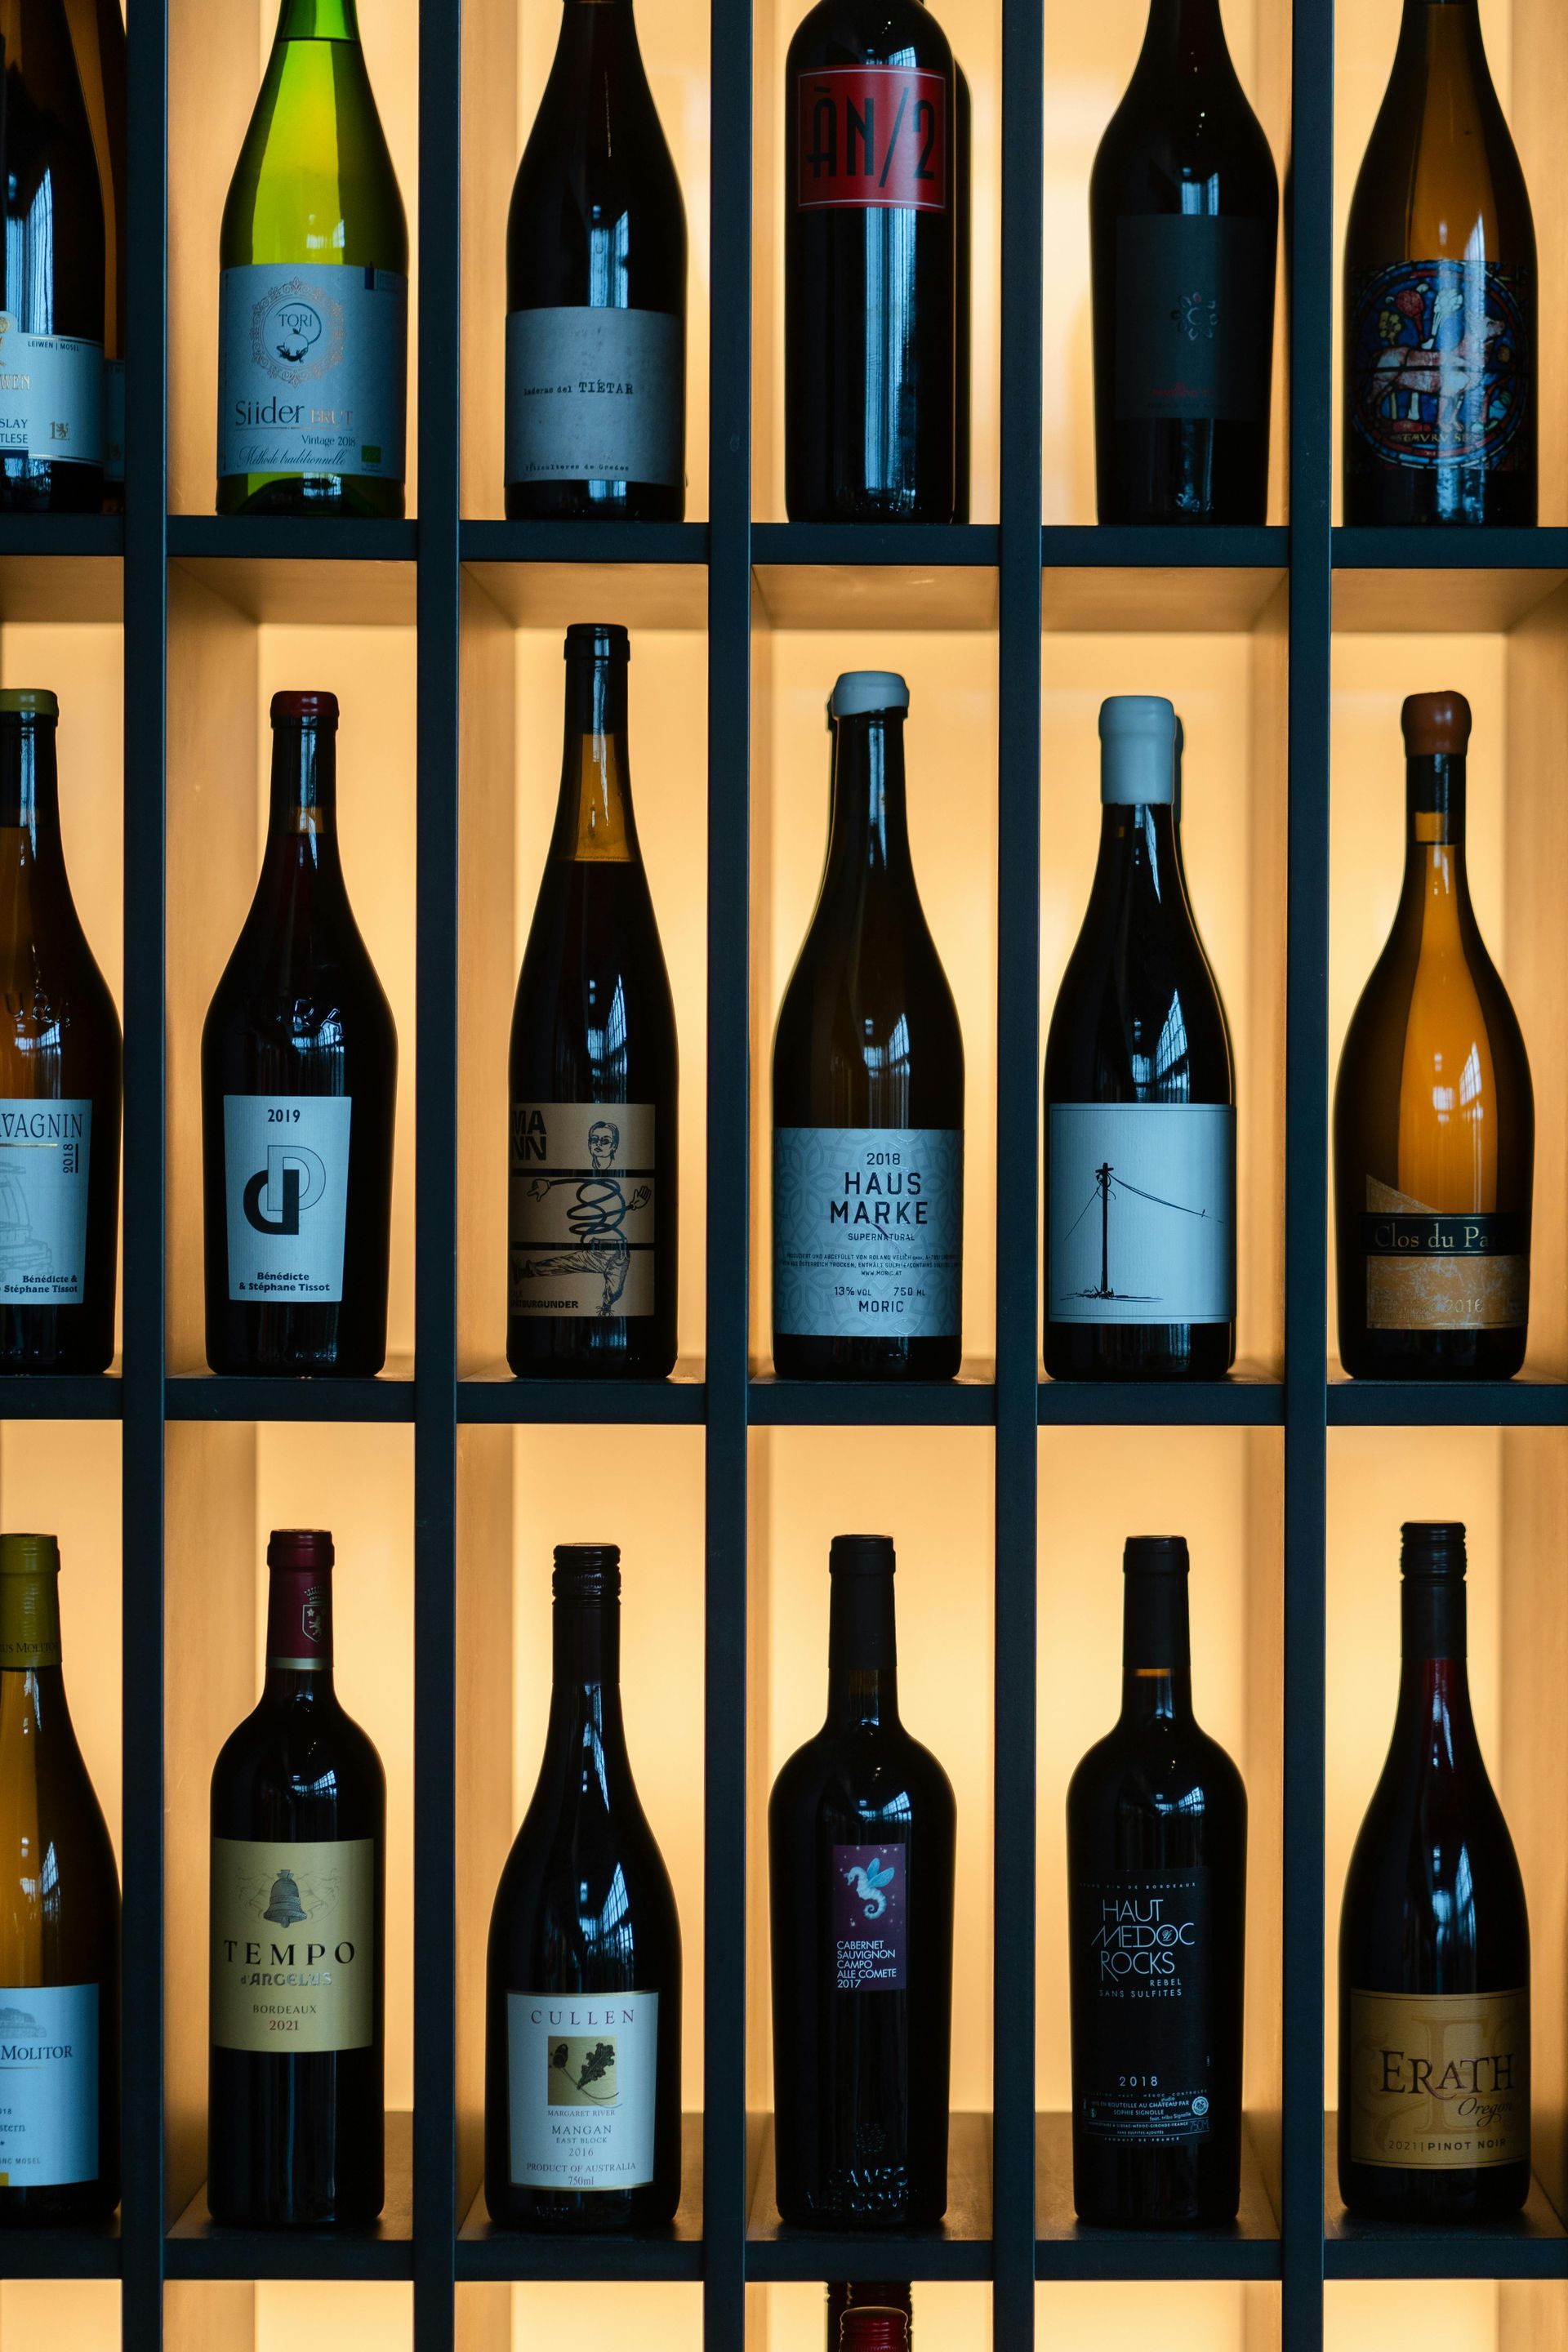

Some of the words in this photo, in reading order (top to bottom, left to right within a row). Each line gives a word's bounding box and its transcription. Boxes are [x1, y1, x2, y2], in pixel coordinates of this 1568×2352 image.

[278, 314, 313, 328] TORI
[28, 341, 54, 349] LEIWEN
[60, 343, 79, 352] MOSEL
[235, 396, 305, 425] Siider
[310, 409, 354, 425] BRUT
[301, 434, 335, 447] Vintage
[337, 437, 356, 447] 2018
[280, 448, 348, 465] traditionnelle
[267, 1109, 301, 1123] 2019
[0, 1113, 83, 1138] VAGNIN
[63, 1143, 74, 1174] 2018
[866, 1152, 901, 1165] 2018
[844, 1172, 921, 1195] HAUS
[830, 1200, 928, 1224] MARKE
[848, 1233, 915, 1242] SUPERNATURAL
[1374, 1223, 1420, 1248] Clos
[1428, 1223, 1455, 1248] du
[22, 1275, 69, 1283] Bénédicte
[70, 1275, 78, 1283] &
[257, 1272, 310, 1281] Bénédicte
[3, 1285, 50, 1294] Stéphane
[248, 1282, 296, 1294] Stéphane
[298, 1283, 330, 1291] Tissot
[834, 1286, 855, 1296] 13%
[893, 1287, 913, 1296] 750
[859, 1300, 904, 1312] MORIC
[1102, 1899, 1164, 1922] HAUT
[836, 1940, 884, 1950] CABERNET
[224, 1940, 355, 1966] TEMPO
[836, 1949, 896, 1959] SAUVIGNON
[836, 1960, 873, 1969] CAMPO
[1100, 1950, 1176, 1983] ROCKS
[836, 1970, 856, 1979] ALLE
[858, 1968, 897, 1979] COMETE
[837, 1980, 862, 1989] 2017
[1149, 1978, 1182, 1987] REBEL
[1098, 1989, 1125, 1998] SANS
[1131, 1989, 1182, 1998] SULFITES
[252, 2004, 317, 2014] BORDEAUX
[531, 2009, 635, 2025] CULLEN
[269, 2020, 299, 2031] 2021
[1379, 2049, 1517, 2100] ERATH
[1118, 2075, 1158, 2087] 2018
[1459, 2097, 1512, 2127] Oregon
[551, 2125, 612, 2135] MANGAN
[1388, 2140, 1417, 2149] 2021
[1428, 2141, 1472, 2150] PINOT
[1477, 2138, 1507, 2149] NOIR
[568, 2148, 594, 2157] 2016
[526, 2163, 568, 2172] PRODUCT
[585, 2163, 636, 2172] AUSTRALIA
[568, 2176, 594, 2185] 750ml
